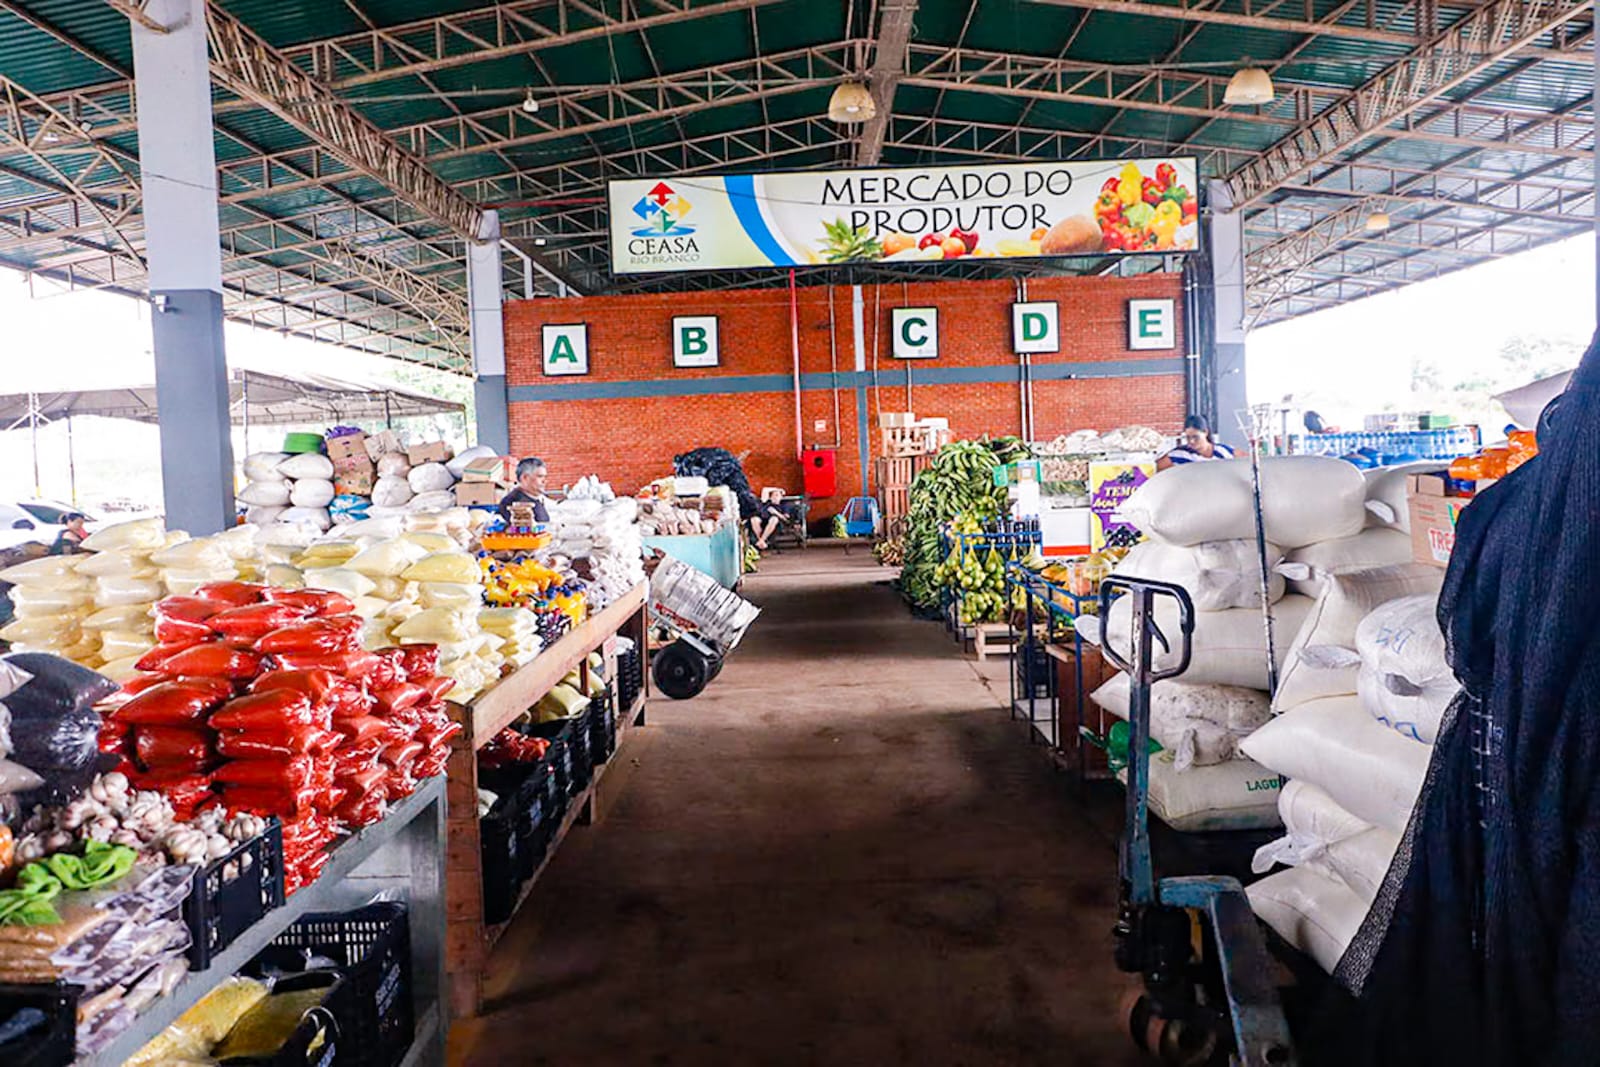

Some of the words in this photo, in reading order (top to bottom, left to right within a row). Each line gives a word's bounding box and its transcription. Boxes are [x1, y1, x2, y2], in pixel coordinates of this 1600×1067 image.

[821, 172, 1011, 205] MERCADO
[1024, 169, 1073, 197] DO
[851, 203, 1051, 236] PRODUTOR
[628, 237, 700, 256] CEASA
[630, 255, 650, 265] RIO
[652, 253, 701, 264] BRANCO
[901, 317, 928, 347] C
[1022, 312, 1048, 341] D
[1139, 309, 1163, 338] E
[549, 335, 578, 364] A
[681, 327, 709, 355] B
[1430, 528, 1455, 553] TRE
[1246, 778, 1279, 792] LAGU
